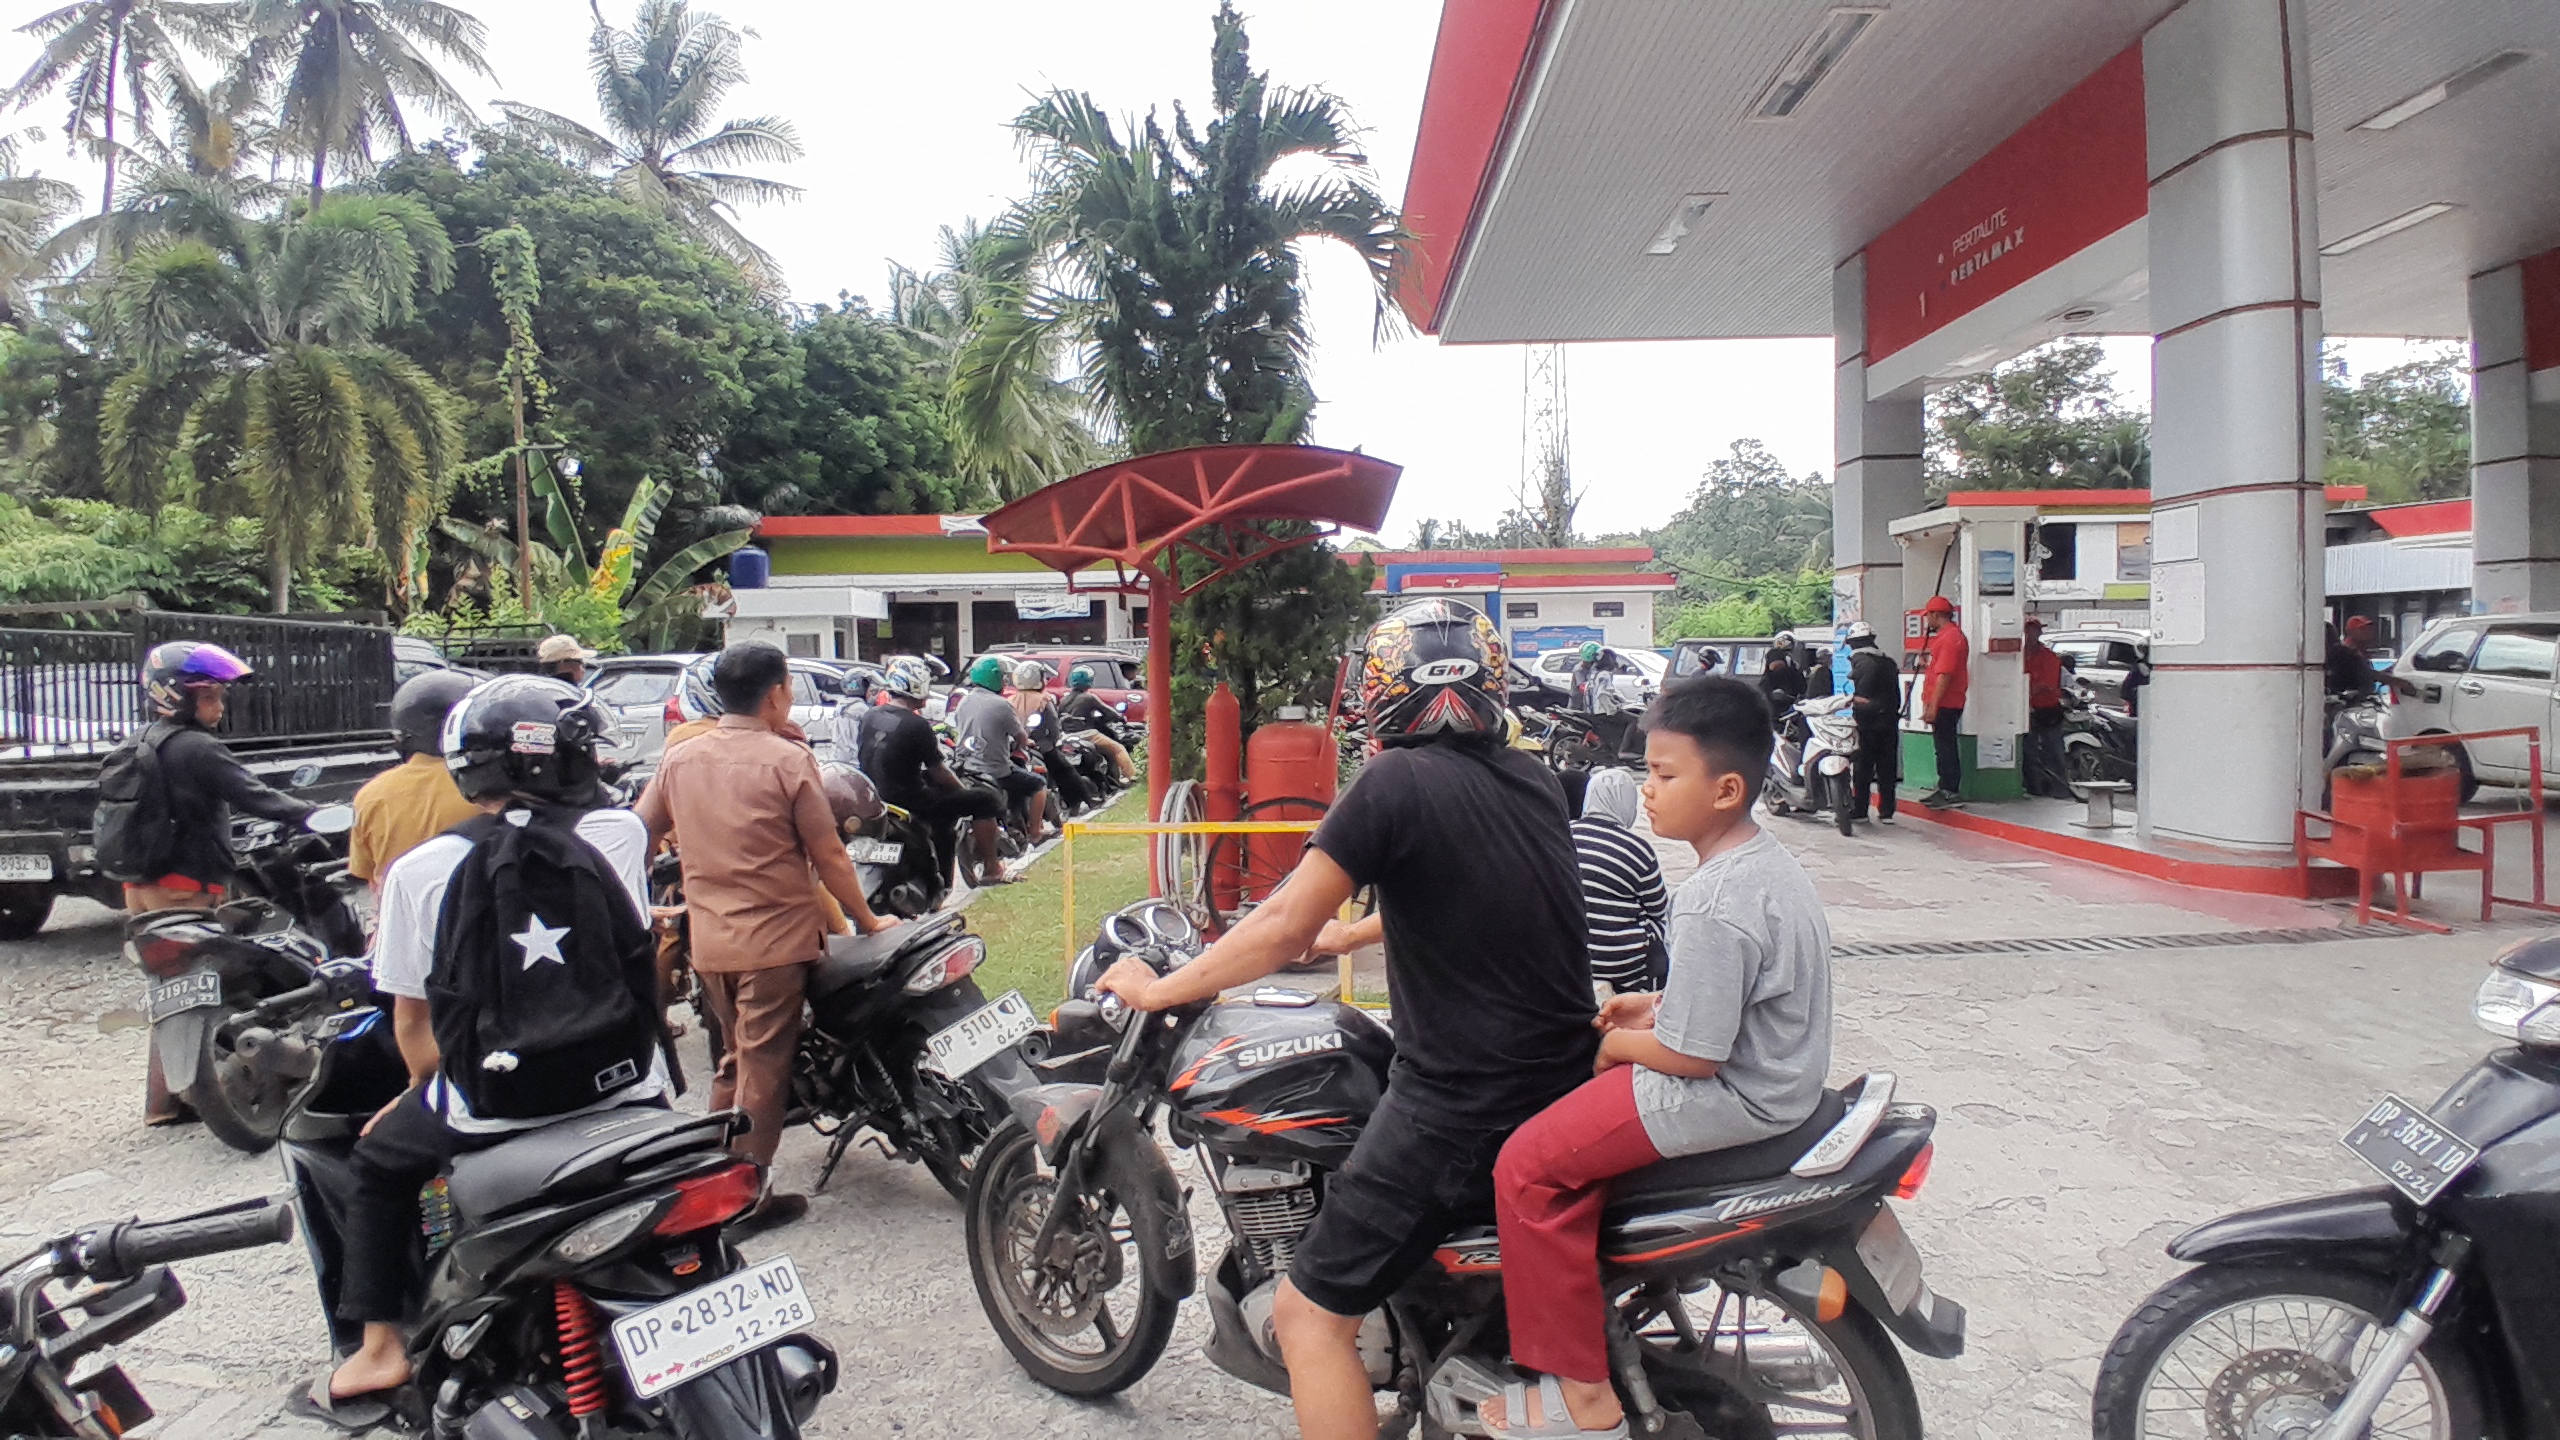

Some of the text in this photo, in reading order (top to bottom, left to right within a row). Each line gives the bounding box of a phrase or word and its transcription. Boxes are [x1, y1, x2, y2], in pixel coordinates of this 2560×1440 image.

[1952, 206, 2008, 257] PERTALITE
[1951, 226, 2024, 285] PERTAMAX
[1427, 664, 1467, 677] GM
[157, 980, 189, 1002] 2197
[960, 1009, 1000, 1041] 5101
[1237, 1032, 1343, 1067] SUZUKI
[2368, 1101, 2401, 1127] DP
[2392, 1117, 2444, 1156] 3627
[1712, 1183, 1852, 1222] Thunder
[626, 1317, 662, 1359] DP
[677, 1283, 752, 1335] 2832
[758, 1265, 794, 1300] ND
